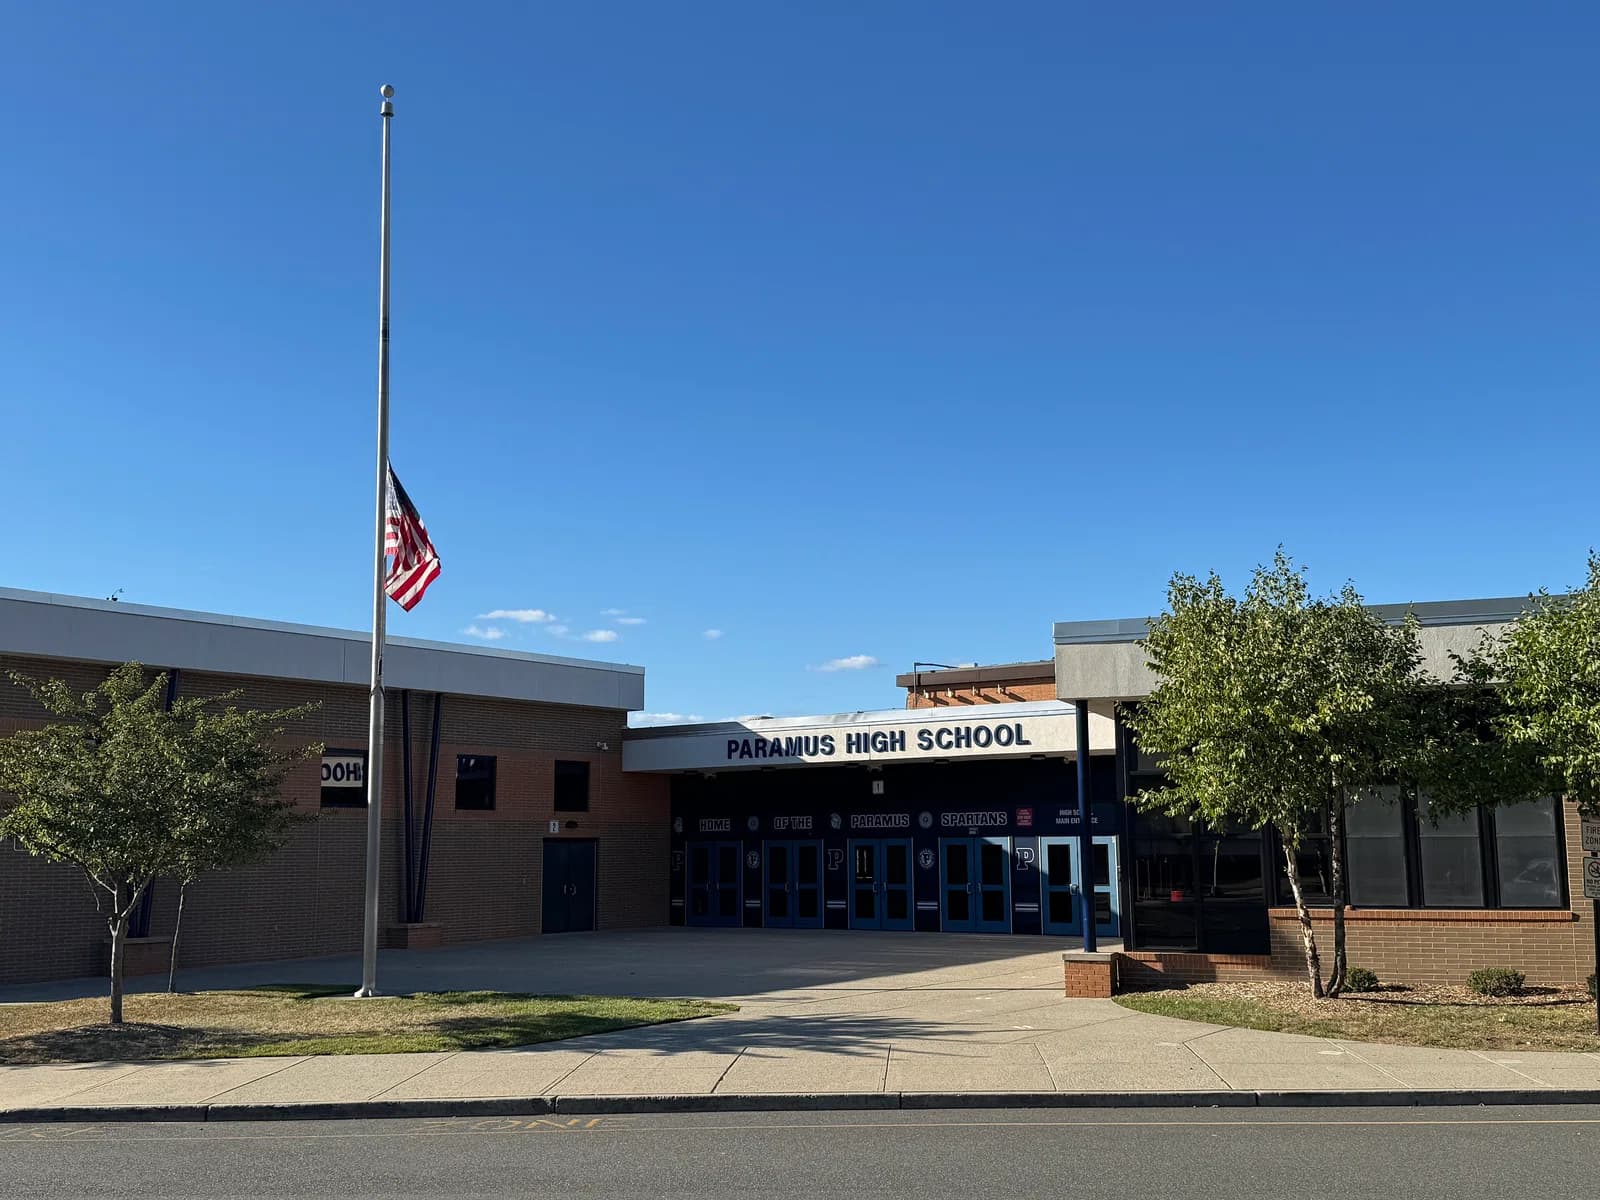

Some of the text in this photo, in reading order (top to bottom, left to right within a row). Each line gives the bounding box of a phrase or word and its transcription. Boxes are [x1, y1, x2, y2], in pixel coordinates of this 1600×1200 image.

[727, 723, 1032, 759] PARAMUS HIGH SCHOOL
[699, 818, 731, 832] HOME
[773, 816, 813, 830] OF THE
[850, 813, 910, 828] PARAMUS
[940, 811, 1008, 826] SPARTANS
[1585, 836, 1600, 846] ZON
[827, 849, 844, 871] P
[1016, 847, 1035, 870] P
